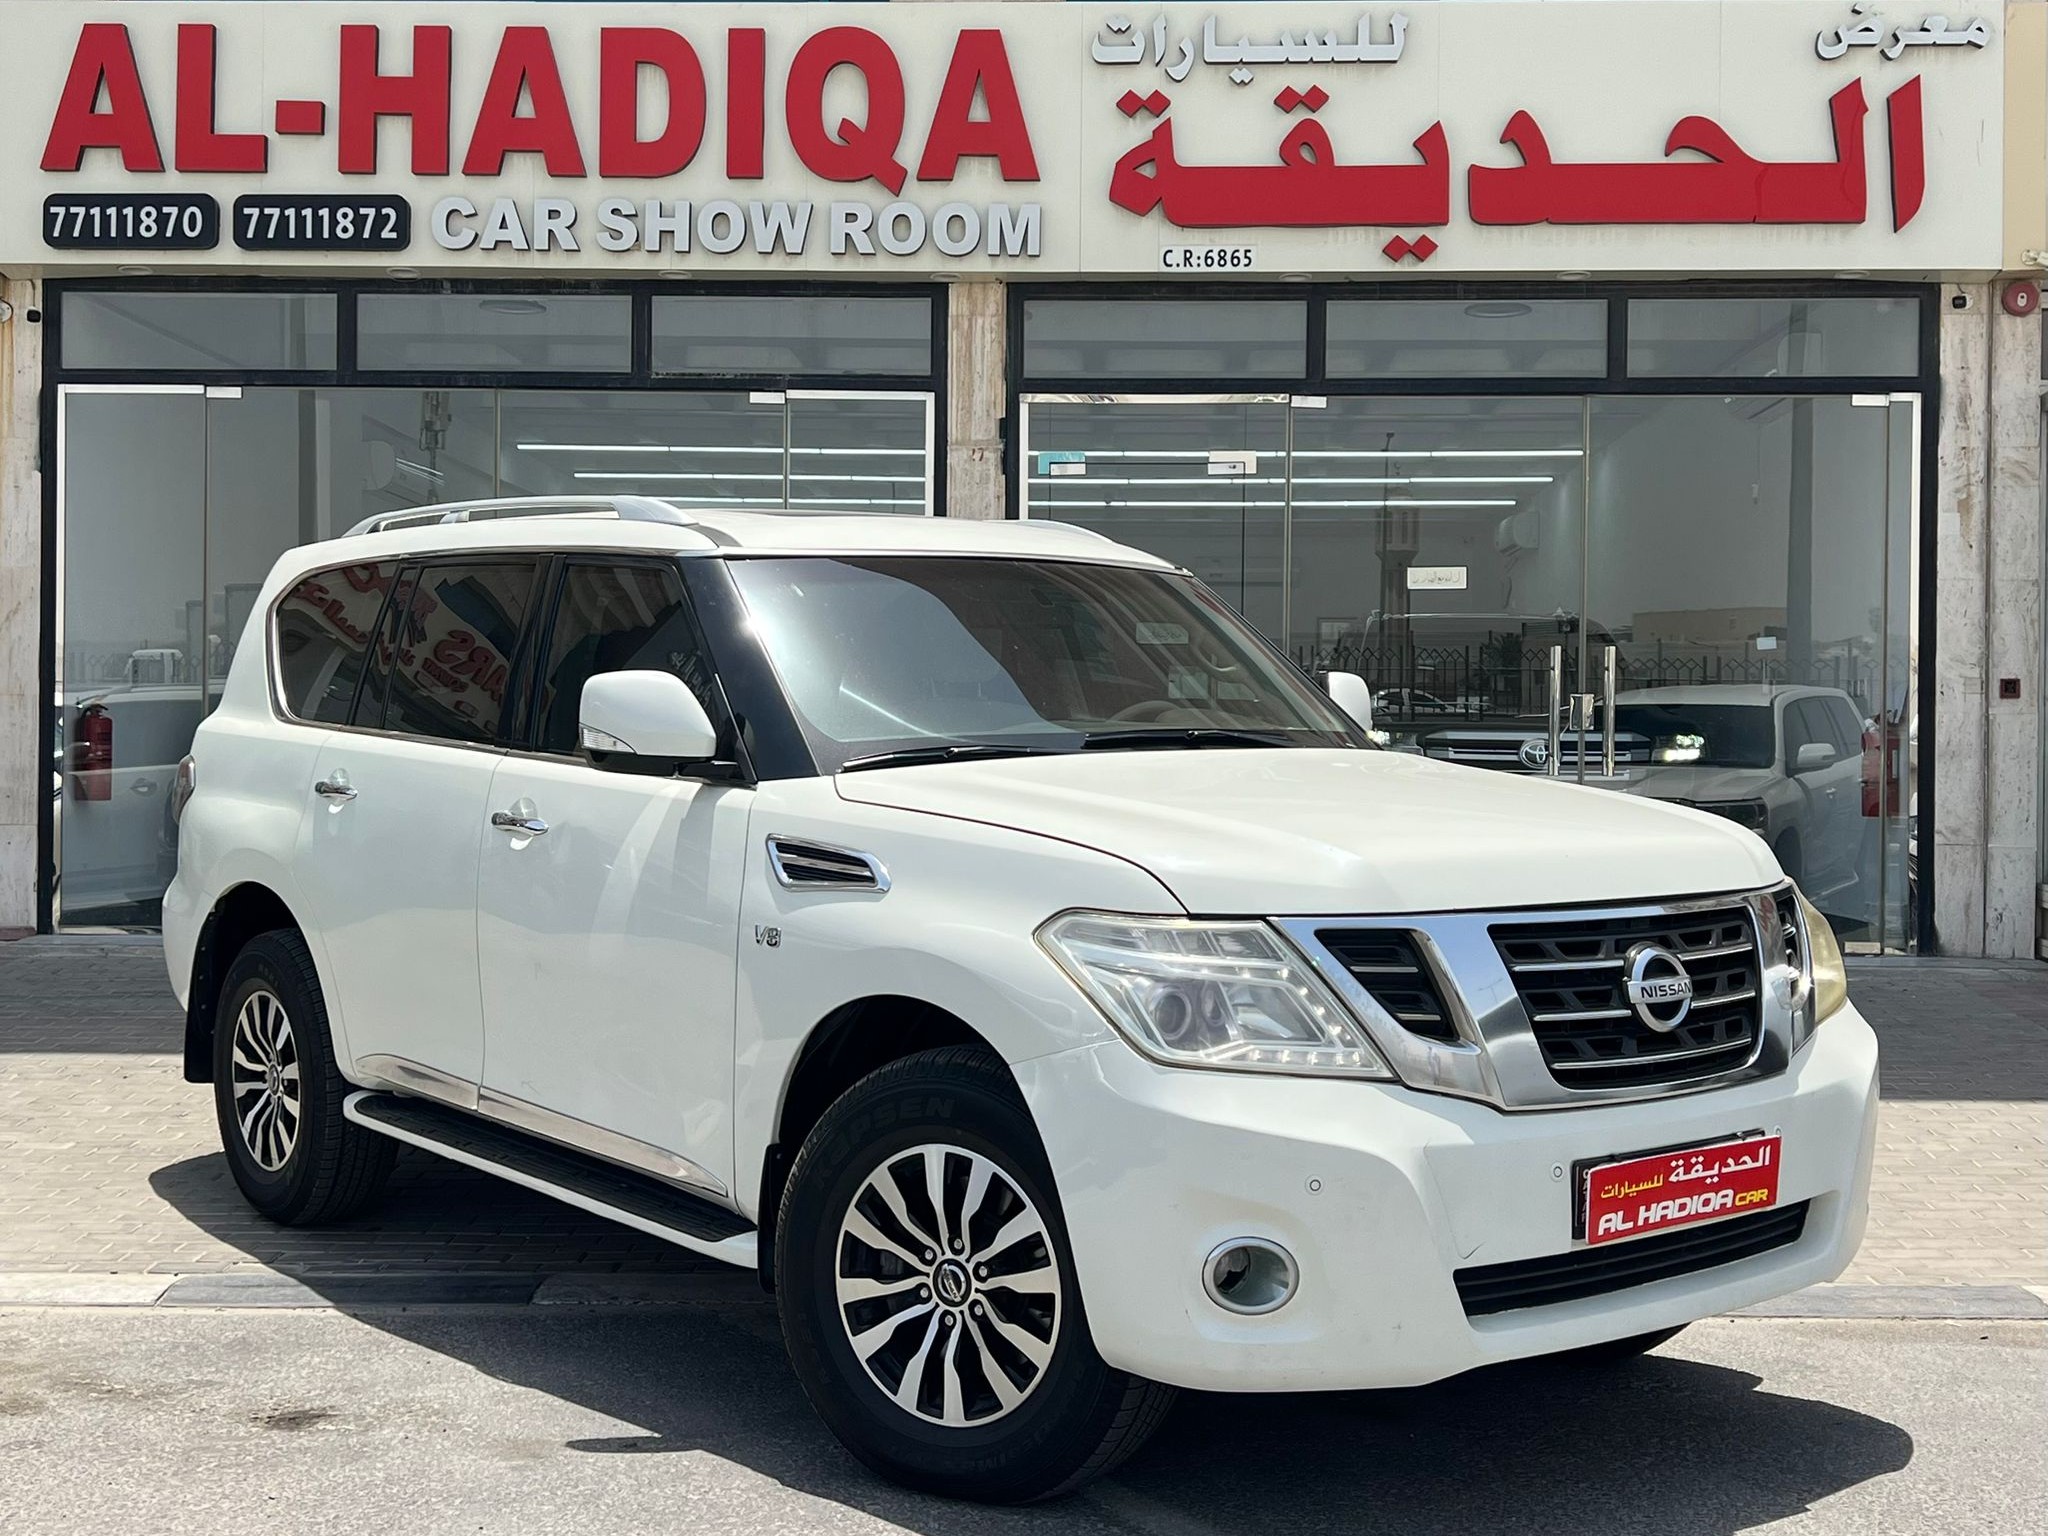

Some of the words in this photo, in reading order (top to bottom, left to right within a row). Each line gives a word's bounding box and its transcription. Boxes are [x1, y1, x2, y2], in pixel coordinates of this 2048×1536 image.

[1092, 11, 1408, 83] للسيارات
[1815, 2, 1990, 61] معرض
[40, 23, 1040, 195] AL-HADIQA
[1109, 74, 1925, 262] الحديقة
[50, 206, 202, 238] 77111870
[243, 207, 398, 239] 77111872
[430, 198, 580, 251] CAR
[596, 200, 812, 254] SHOW
[830, 203, 1041, 256] ROOM
[1163, 249, 1252, 267] C.R:6865
[755, 924, 781, 948] V8
[1640, 980, 1692, 999] NISSAN
[1668, 1144, 1772, 1184] الحديقة
[1600, 1173, 1664, 1199] للسيارات
[1597, 1210, 1634, 1236] AL
[1637, 1188, 1735, 1227] HADIQA
[1735, 1188, 1769, 1207] CAR
